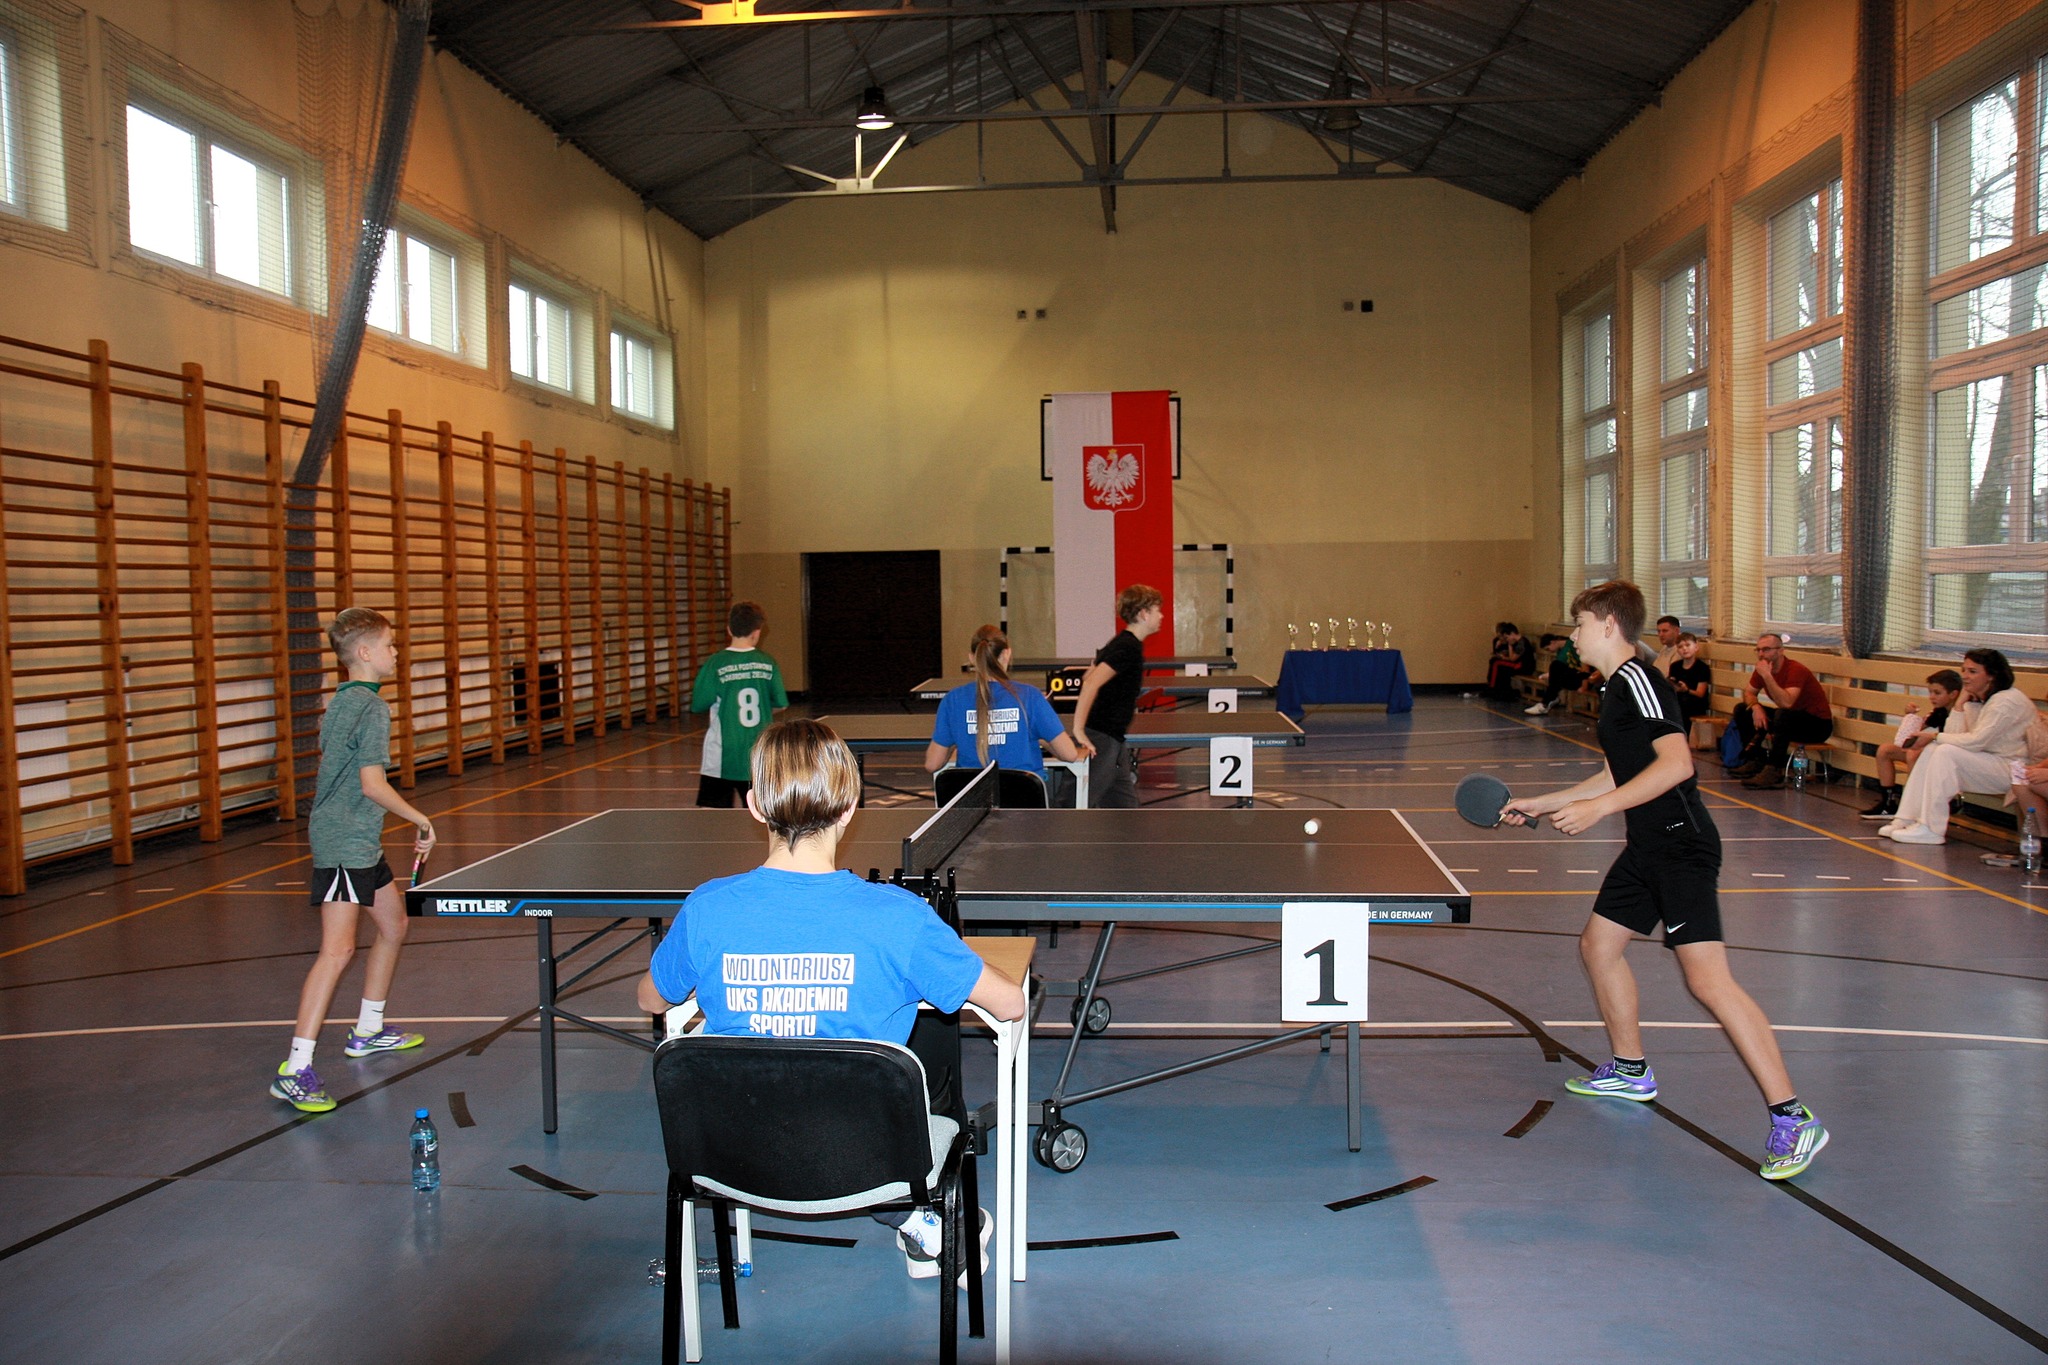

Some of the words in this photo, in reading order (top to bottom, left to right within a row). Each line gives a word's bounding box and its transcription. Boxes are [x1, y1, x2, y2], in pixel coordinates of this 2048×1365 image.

[738, 687, 761, 728] 8
[987, 733, 1006, 746] ORTU
[1219, 755, 1242, 789] 2
[436, 899, 508, 912] KETTLER
[524, 909, 553, 917] INDOOR
[1378, 910, 1389, 919] IN
[1390, 910, 1434, 919] GERMANY
[725, 957, 852, 982] WOLONTARIUSZ
[1303, 939, 1349, 1006] 1
[726, 987, 758, 1012] UKS
[761, 986, 849, 1013] AKADEMIA
[749, 1013, 817, 1037] SPORTU
